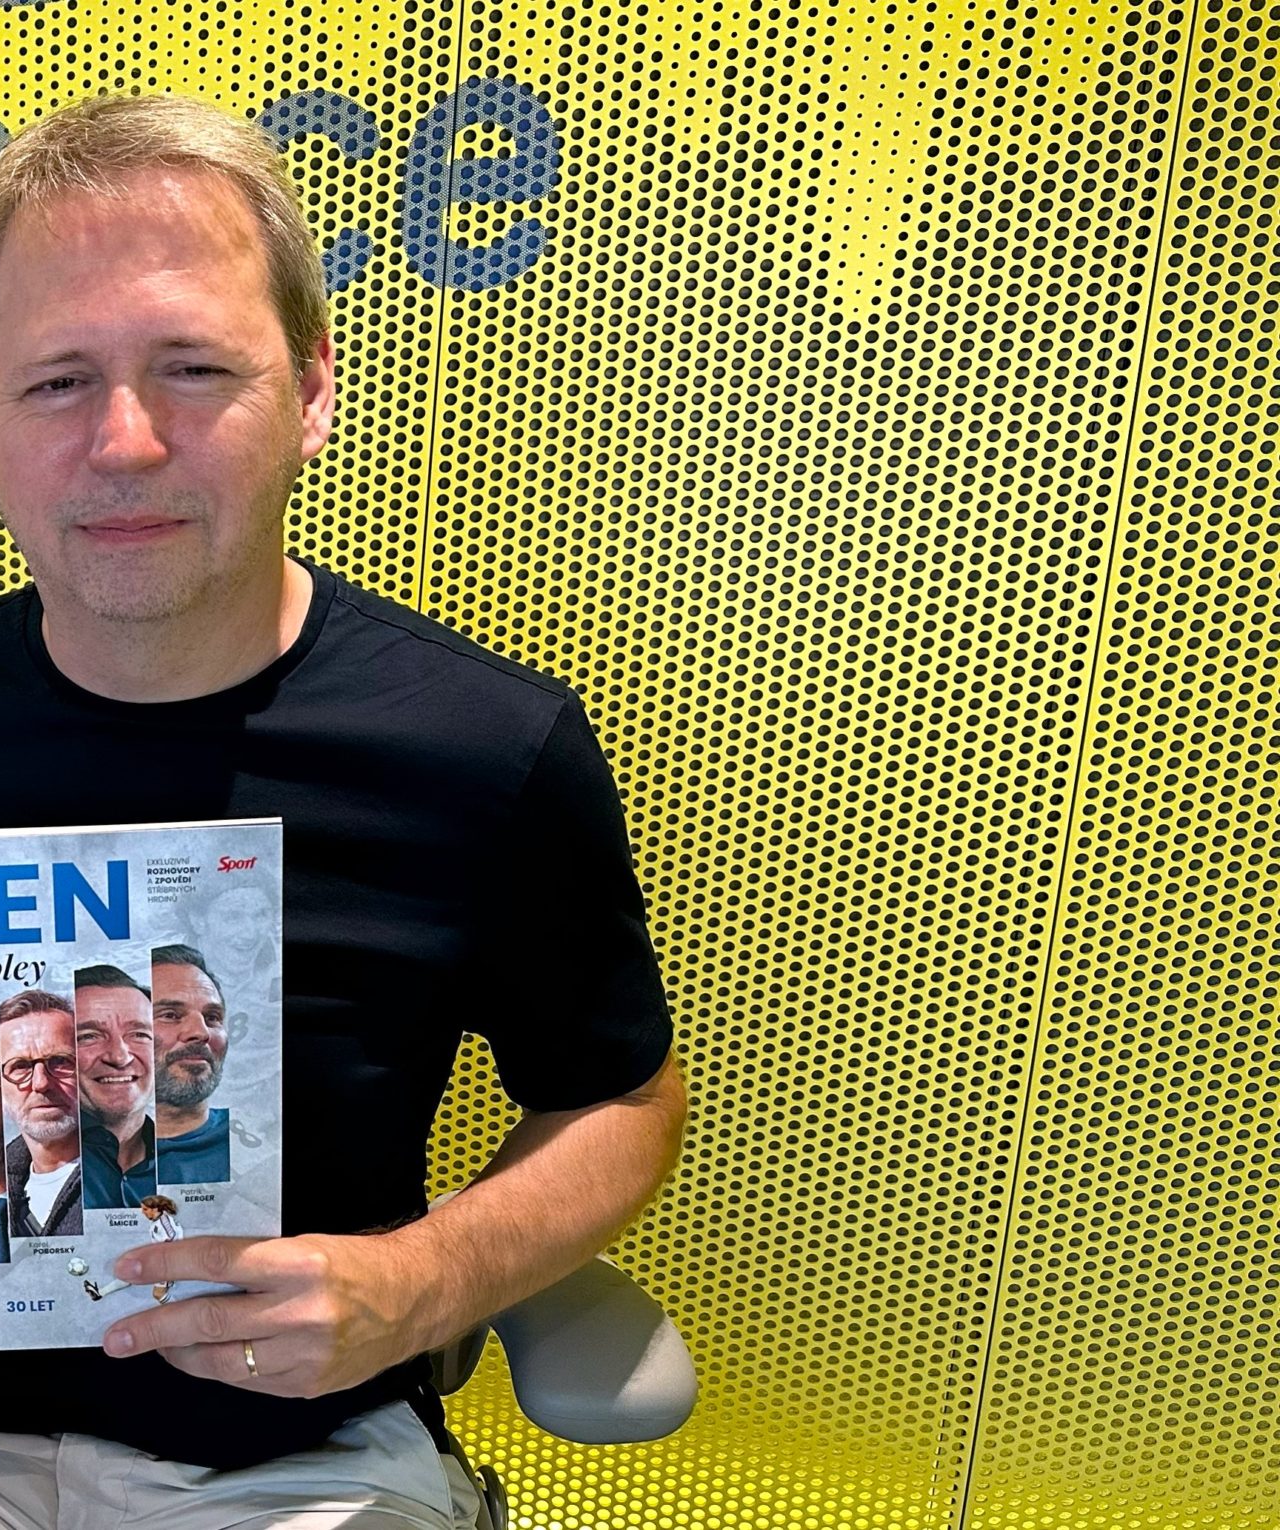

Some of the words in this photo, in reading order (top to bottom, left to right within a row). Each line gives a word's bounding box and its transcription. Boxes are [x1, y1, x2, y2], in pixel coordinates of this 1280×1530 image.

[146, 856, 191, 866] EXKLUZIVNÍ
[217, 856, 257, 873] Sport
[146, 866, 200, 875] ROZHOVORY
[155, 875, 192, 885] ZPOVĚDI
[184, 1195, 215, 1203] BERGER
[33, 1246, 75, 1255] POBORSKÝ
[6, 1301, 26, 1313] 30
[30, 1299, 55, 1312] LET
